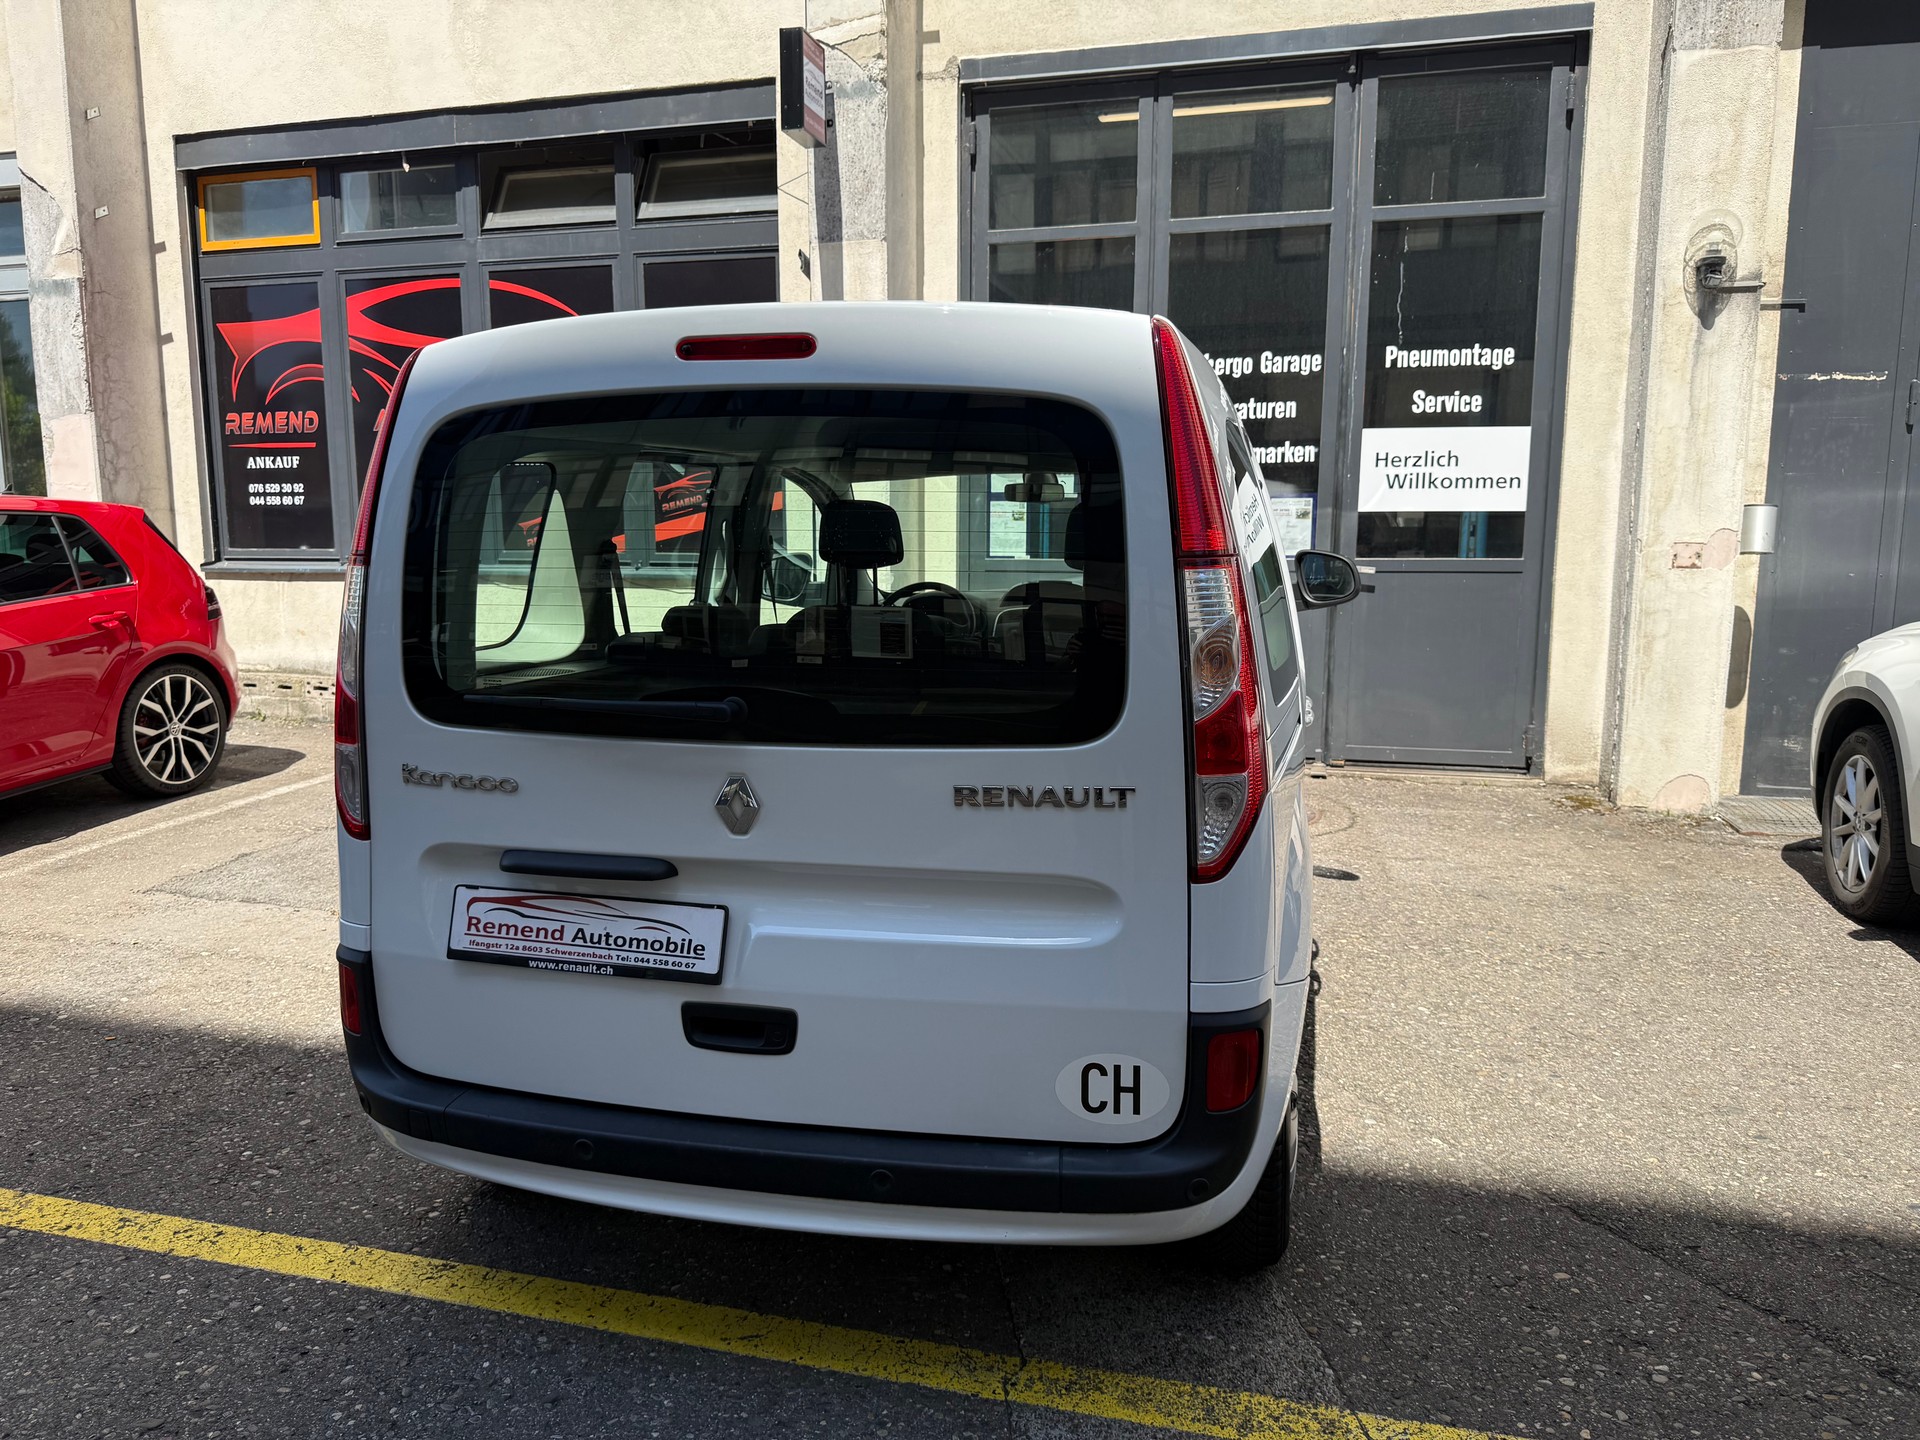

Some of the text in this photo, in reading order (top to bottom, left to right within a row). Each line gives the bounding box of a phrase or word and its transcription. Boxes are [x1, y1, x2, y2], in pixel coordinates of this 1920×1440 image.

[1260, 351, 1322, 376] Garage
[1385, 343, 1516, 370] Pneumontage
[1411, 389, 1483, 413] Service
[225, 410, 319, 435] REMEND
[247, 456, 300, 469] ANKAUF
[1375, 450, 1459, 468] Herzlich
[248, 483, 305, 493] 076 529 30 92
[1386, 472, 1522, 489] Willkommen
[249, 495, 305, 506] 044 558 60 67
[662, 495, 703, 511] REMEND
[402, 763, 520, 793] Kangoo
[953, 785, 1137, 808] RENAULT
[466, 915, 706, 957] Remend Automobile
[468, 940, 697, 970] Ifangstr 12a 8603 Schwerzenbach Tel: 044 558 60 67
[528, 960, 614, 976] www.renault.ch
[1080, 1062, 1141, 1116] CH
